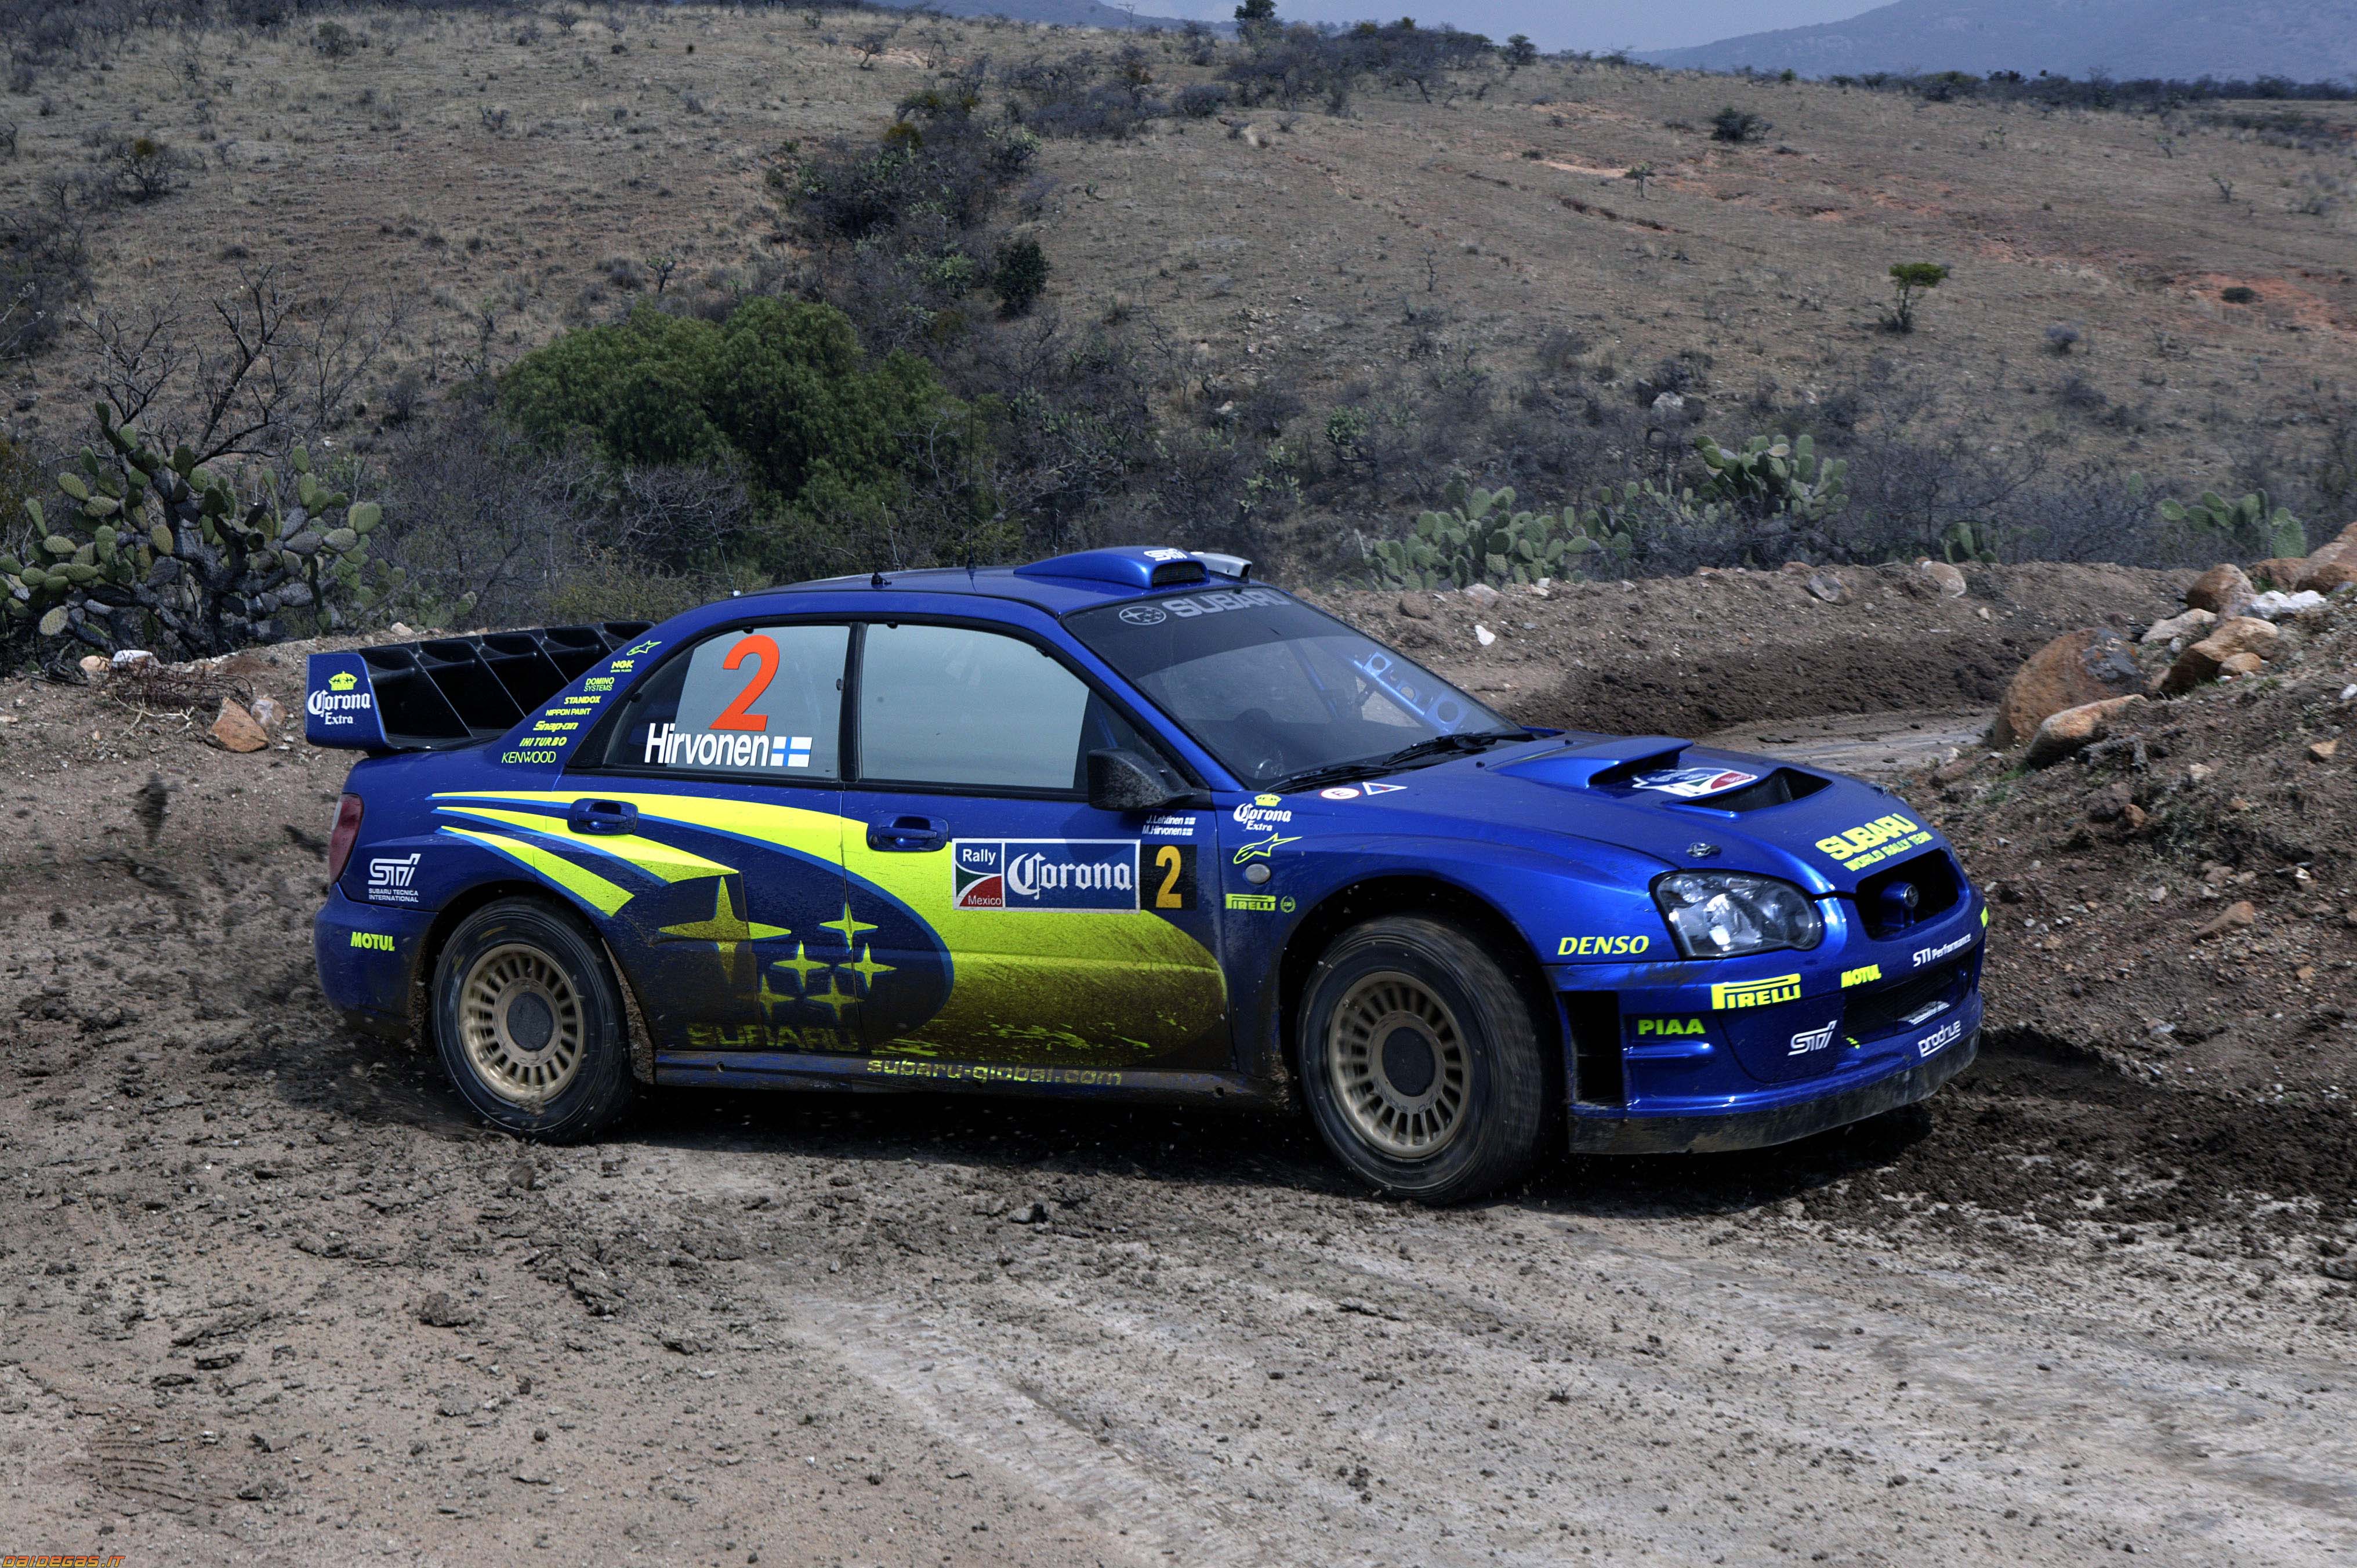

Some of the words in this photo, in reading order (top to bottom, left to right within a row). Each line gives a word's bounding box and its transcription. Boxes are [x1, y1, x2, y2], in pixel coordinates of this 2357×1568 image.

[1162, 588, 1291, 618] SUBARU
[611, 660, 634, 669] NGK
[586, 677, 615, 685] DOMINO
[709, 634, 780, 732] 2
[307, 689, 371, 717] Corona
[564, 696, 601, 704] STANDOX
[325, 712, 354, 725] Extra
[533, 721, 579, 732] Snap-on
[534, 737, 567, 746] TURBO
[644, 723, 770, 767] Hirvonen
[502, 752, 557, 763] KENWOOD
[1233, 803, 1292, 823] Corona
[1246, 821, 1273, 832] Extra
[1815, 813, 1919, 860] SUBARU
[963, 849, 996, 866] Rally
[1843, 850, 1885, 872] WORLD
[1007, 852, 1133, 900] Corona
[1156, 845, 1182, 908] 2
[369, 894, 419, 902] INTERNATIONAL
[968, 895, 1002, 906] Mexico
[1225, 894, 1276, 911] PIRELLI
[350, 931, 396, 951] MOTUL
[1557, 935, 1649, 955] DENSO
[1932, 933, 1971, 960] Performance
[1841, 964, 1881, 988] MOTUL
[1711, 973, 1801, 1010] PIRELLI
[1638, 1019, 1706, 1035] PIAA
[867, 1058, 1122, 1086] subaru-global.com
